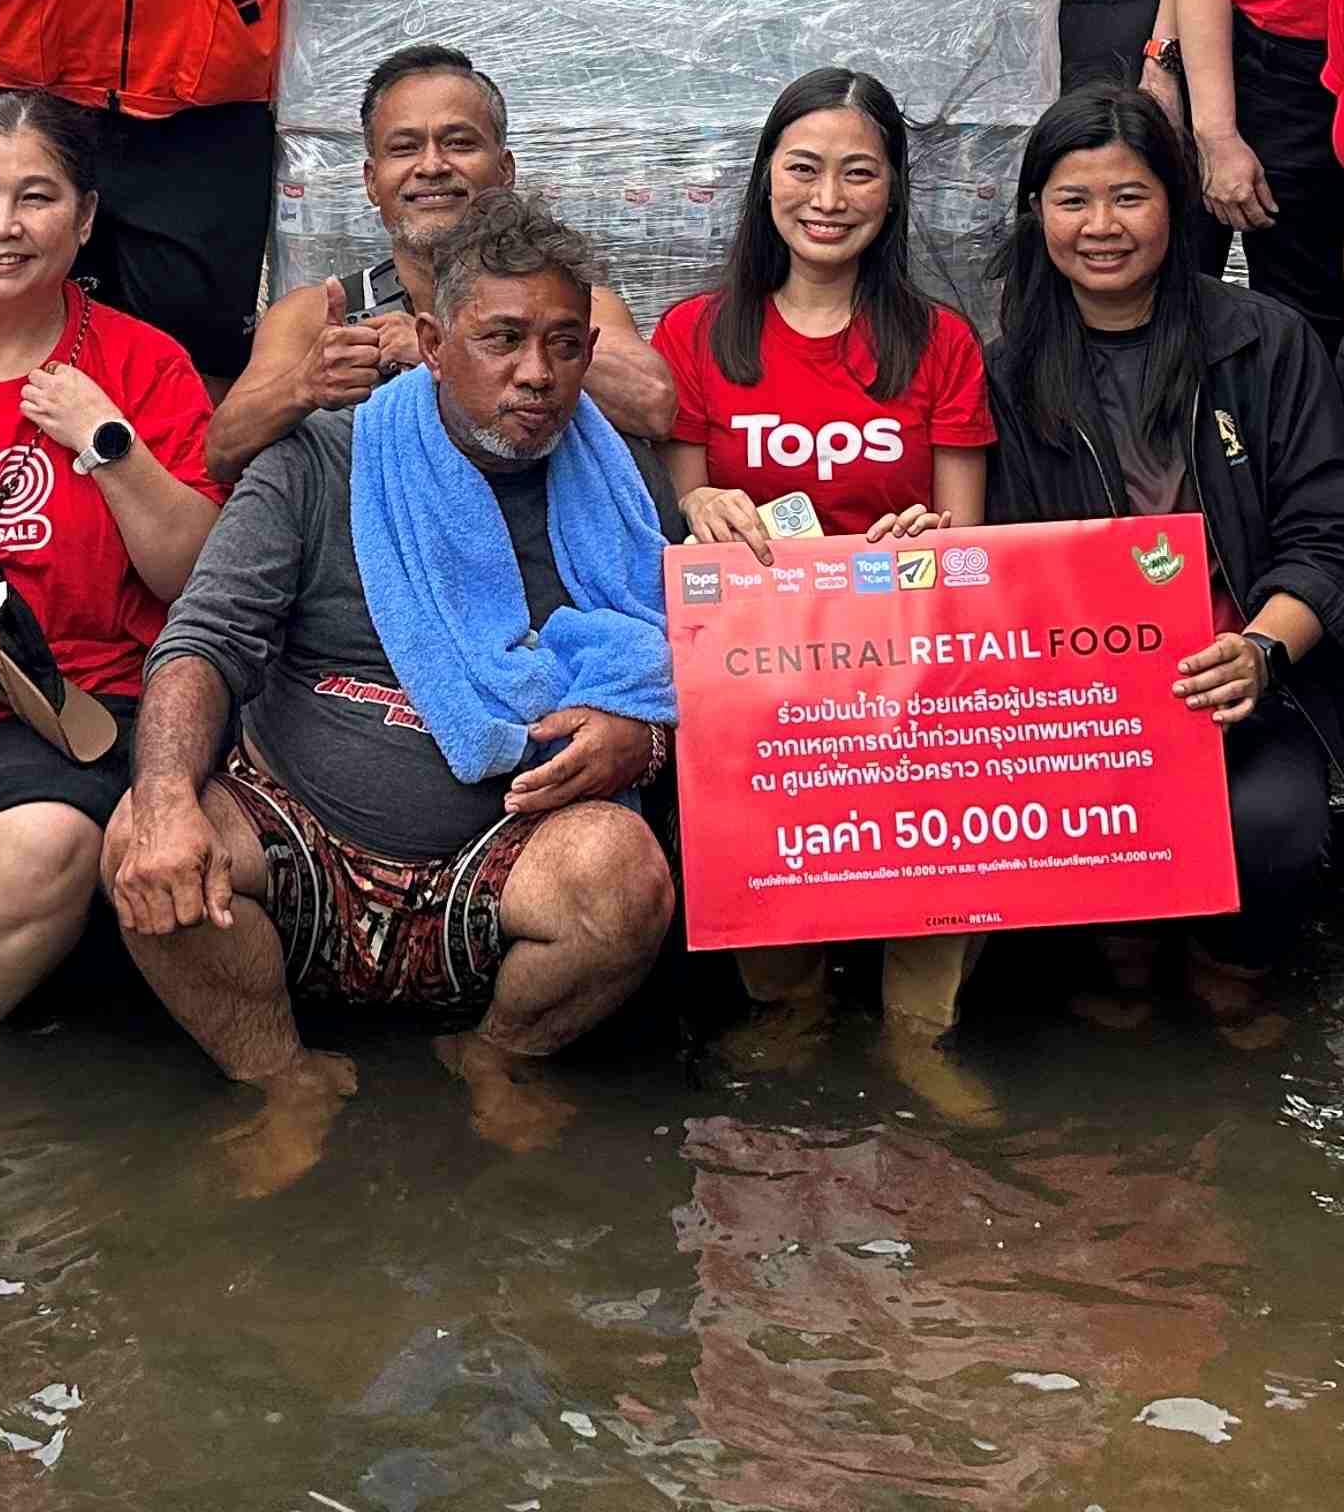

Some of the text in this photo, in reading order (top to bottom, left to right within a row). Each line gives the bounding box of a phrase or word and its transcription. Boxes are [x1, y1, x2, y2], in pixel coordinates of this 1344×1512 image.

[730, 413, 904, 481] Tops
[683, 572, 719, 588] Tops
[726, 573, 762, 588] Tops
[770, 567, 805, 583] Tops
[813, 561, 847, 575] Tops
[856, 560, 889, 573] Tops
[1049, 623, 1163, 657] FOOD
[777, 681, 1118, 724] ร่วมปันน้ำใจ ช่วยเหลือผู้ประสบภัย
[757, 717, 1143, 760] จากเหตุการณ์น้ำท่วมกรุงเทพมหานคร
[751, 749, 1154, 797] ณ ศูนย์พักพิงชั่วคราว กรุงเทพมหานคร
[776, 802, 1138, 870] มูลค่า 50,000 บาท
